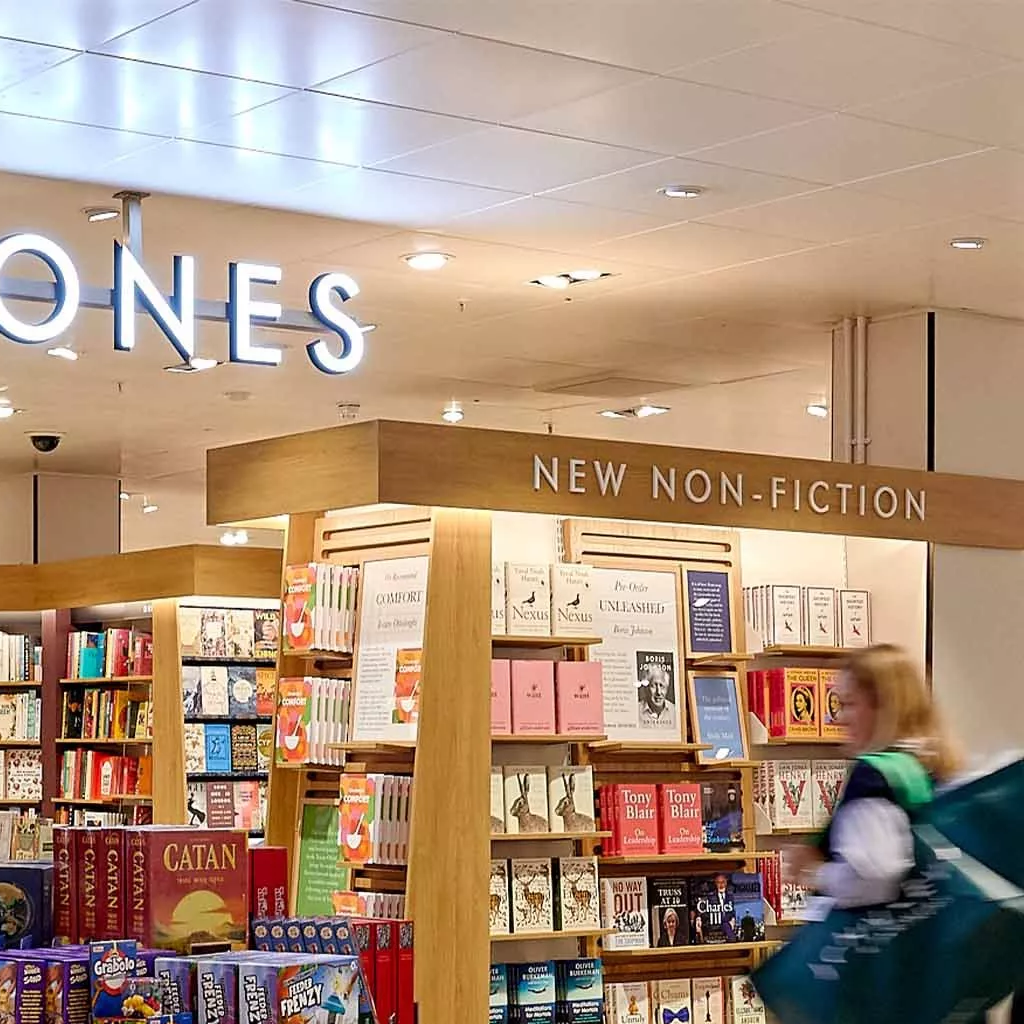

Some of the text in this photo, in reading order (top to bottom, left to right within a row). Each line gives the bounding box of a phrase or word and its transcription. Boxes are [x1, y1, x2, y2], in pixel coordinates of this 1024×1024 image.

[533, 454, 927, 521] NEW NON-FICTION
[376, 590, 424, 606] COMFORT
[512, 605, 549, 621] Nexus
[558, 607, 593, 623] Nexus
[598, 599, 665, 615] UNLEASHED
[645, 655, 666, 664] BORIS
[779, 771, 807, 780] HENRY
[816, 771, 844, 780] HENRY
[621, 789, 652, 808] Tony
[666, 789, 697, 807] Tony
[780, 780, 806, 816] V
[626, 804, 656, 819] Blair
[671, 804, 700, 818] Blair
[634, 828, 645, 836] On
[679, 828, 690, 836] On
[624, 836, 657, 847] Leadership
[668, 836, 700, 846] Leadership
[163, 843, 238, 873] CATAN
[58, 849, 70, 906] CATAN
[84, 849, 95, 909] CATAN
[106, 849, 119, 910] CATAN
[132, 850, 145, 911] CATAN
[612, 880, 643, 893] NO WAY
[657, 888, 682, 897] TRUSS
[613, 893, 643, 913] OUT
[660, 897, 670, 905] AT
[697, 898, 733, 913] Charles
[709, 913, 722, 925] III
[94, 957, 135, 976] Grabolo
[288, 977, 313, 997] FEEDER
[660, 987, 689, 999] Chums
[214, 983, 225, 1017] FEEDER
[257, 987, 267, 1020] FEEDER
[280, 983, 323, 1018] FRENZY
[621, 1015, 645, 1024] Unruly
